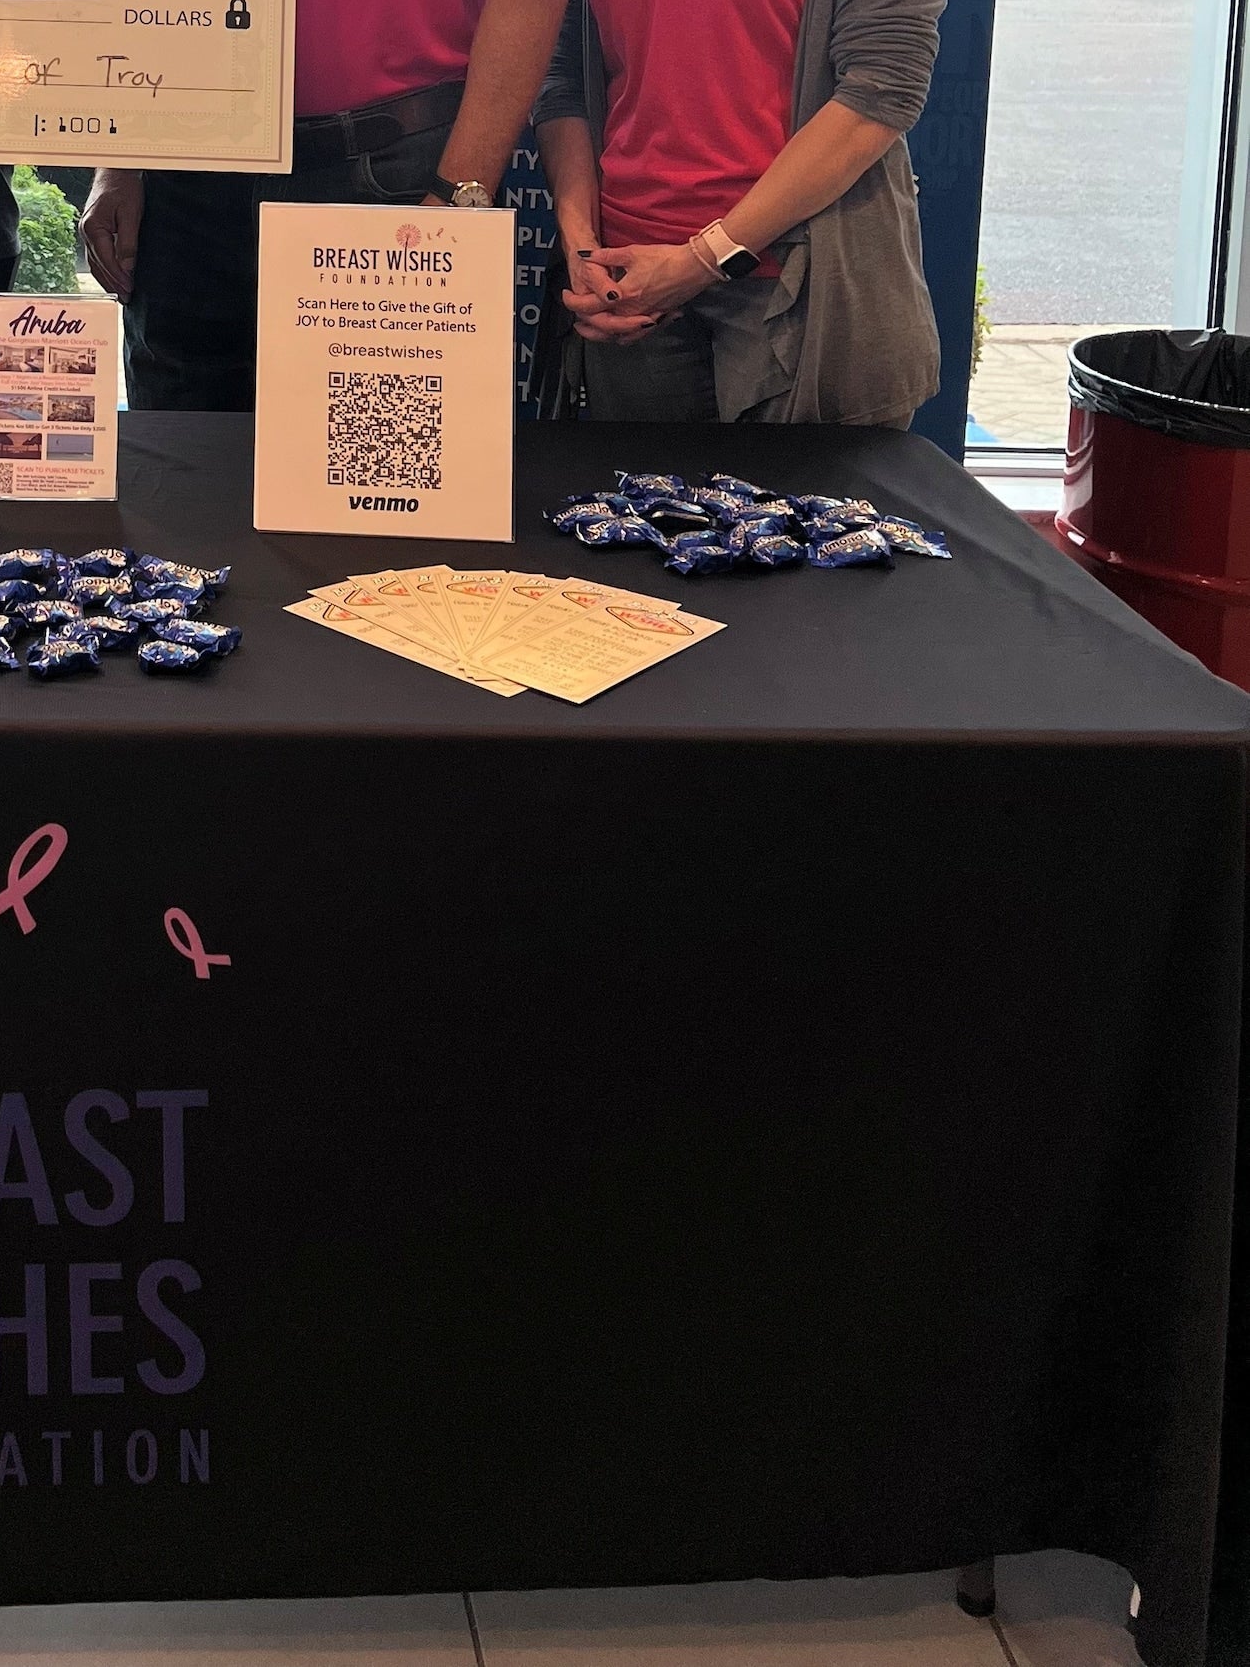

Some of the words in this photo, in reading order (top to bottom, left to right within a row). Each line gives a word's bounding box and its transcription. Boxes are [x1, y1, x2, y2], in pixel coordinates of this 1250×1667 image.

[124, 9, 212, 27] DOLLARS
[96, 55, 165, 98] Troy
[313, 247, 380, 270] BREAST
[386, 248, 453, 273] WISHES
[319, 273, 447, 287] FOUNDATION
[297, 297, 327, 310] Scan
[330, 299, 359, 311] Here
[362, 301, 375, 311] to
[378, 300, 406, 312] Give
[409, 301, 430, 314] the
[433, 302, 456, 315] Gift
[459, 302, 473, 315] of
[9, 306, 86, 335] Aruba
[295, 315, 320, 327] JOY
[322, 317, 336, 328] to
[338, 316, 377, 330] Breast
[379, 318, 423, 331] Cancer
[426, 319, 476, 333] Patients
[328, 342, 443, 360] @breastwishes
[349, 495, 419, 513] venmo
